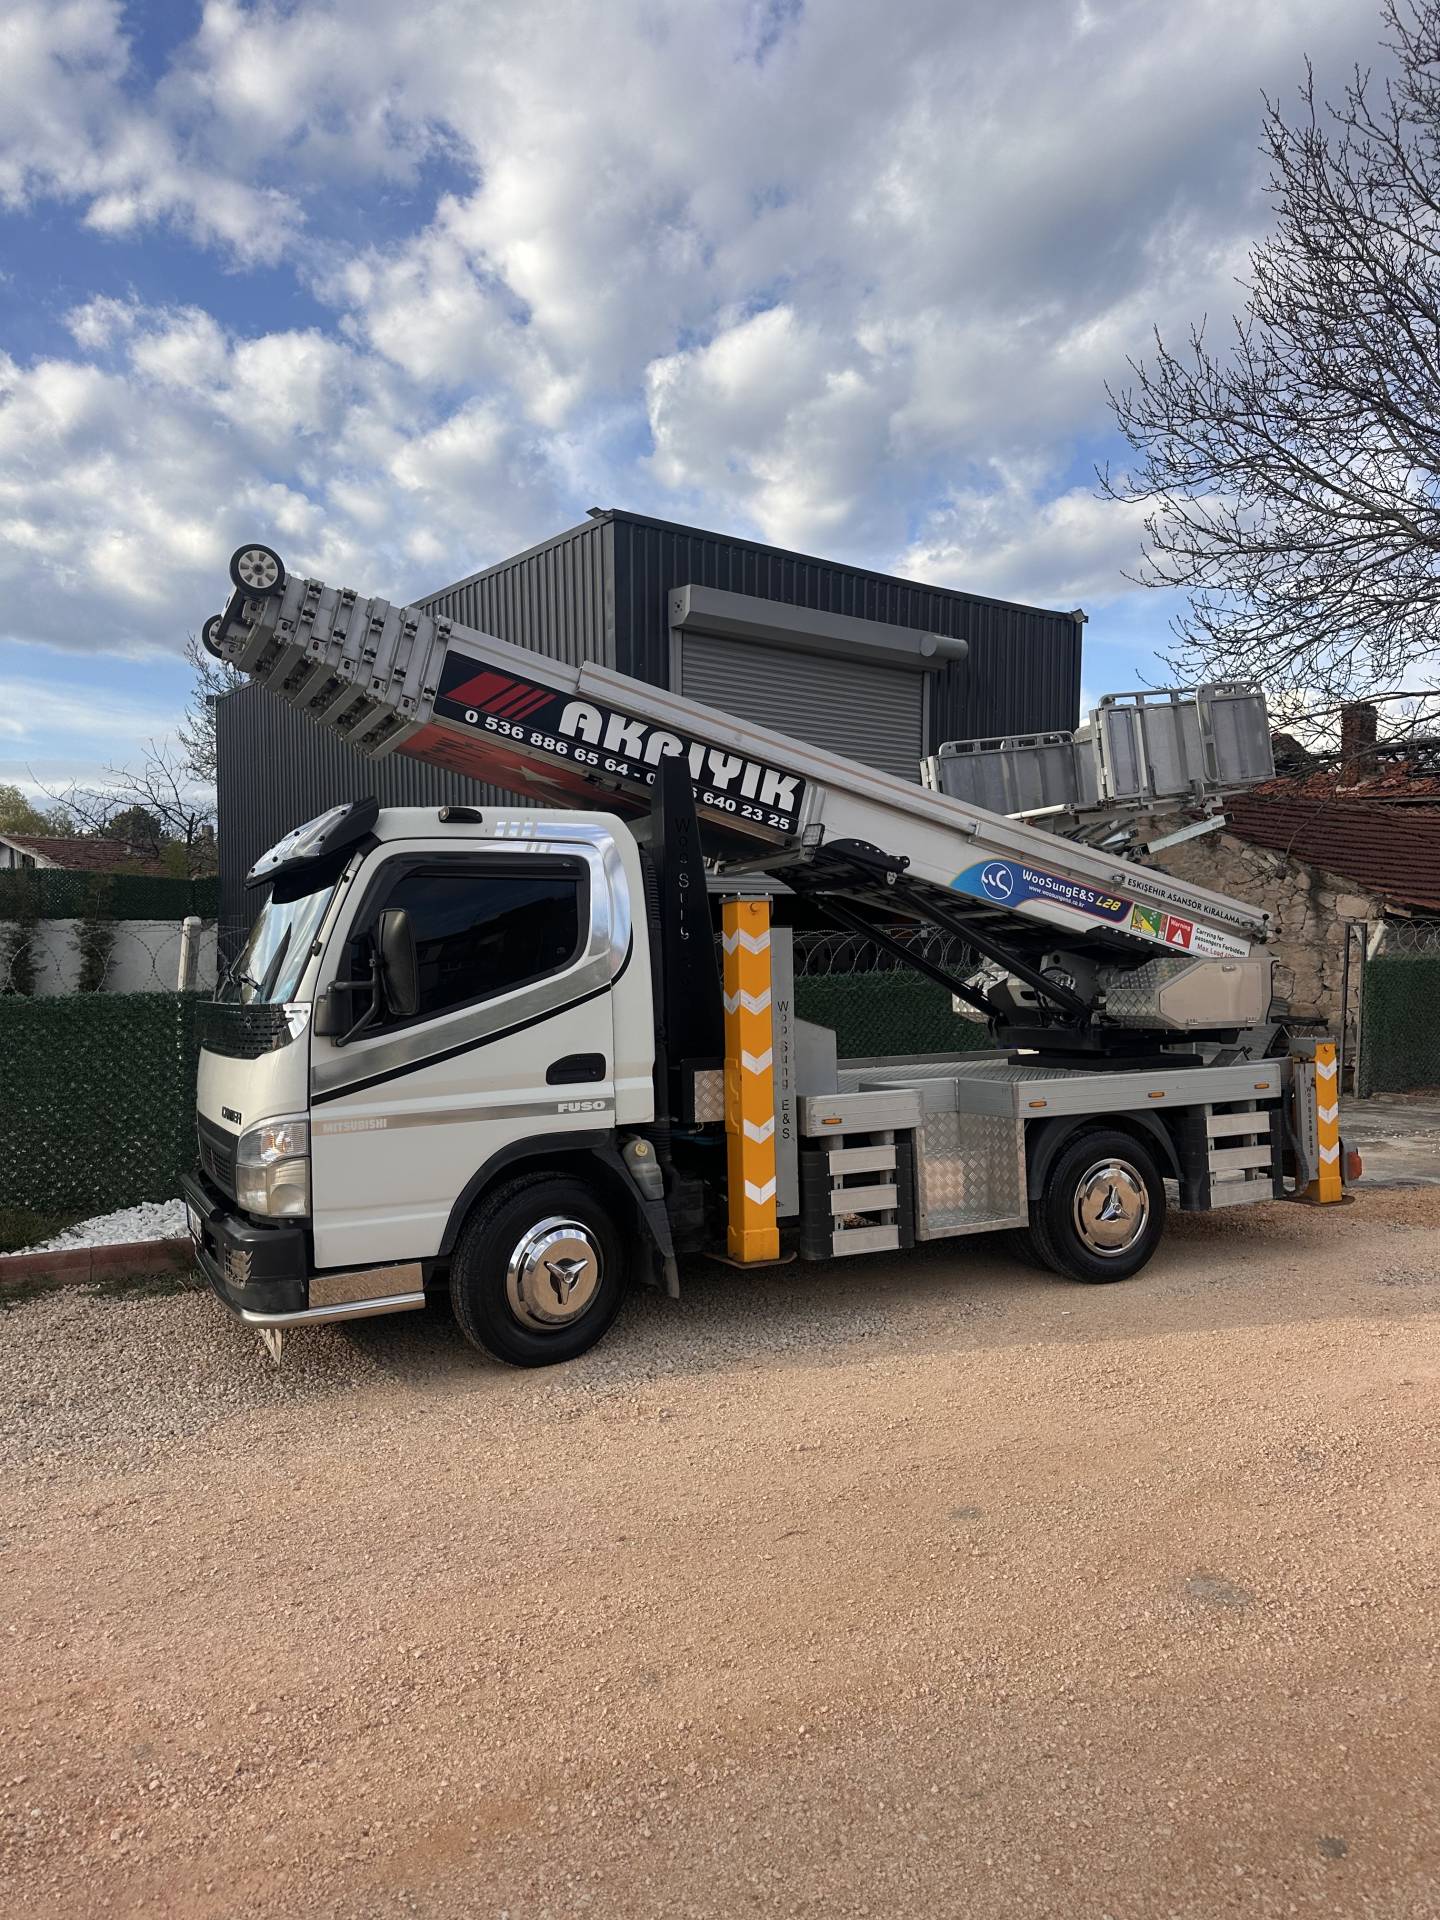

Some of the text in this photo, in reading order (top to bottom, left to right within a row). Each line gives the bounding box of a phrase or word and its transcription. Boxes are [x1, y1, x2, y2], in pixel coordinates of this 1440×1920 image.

[465, 710, 479, 723] 0
[484, 716, 524, 739] 536
[530, 732, 568, 755] 886
[574, 748, 599, 765] 65
[604, 758, 629, 776] 64
[703, 792, 737, 812] 640
[740, 805, 763, 821] 23
[767, 814, 790, 830] 25
[1022, 869, 1122, 912] WooSungE&S L28
[1171, 918, 1191, 932] Warning
[1196, 927, 1217, 940] Carrying
[557, 1100, 606, 1113] FUSO
[321, 1118, 388, 1134] MITSUBISHI
[781, 1099, 791, 1140] E&S
